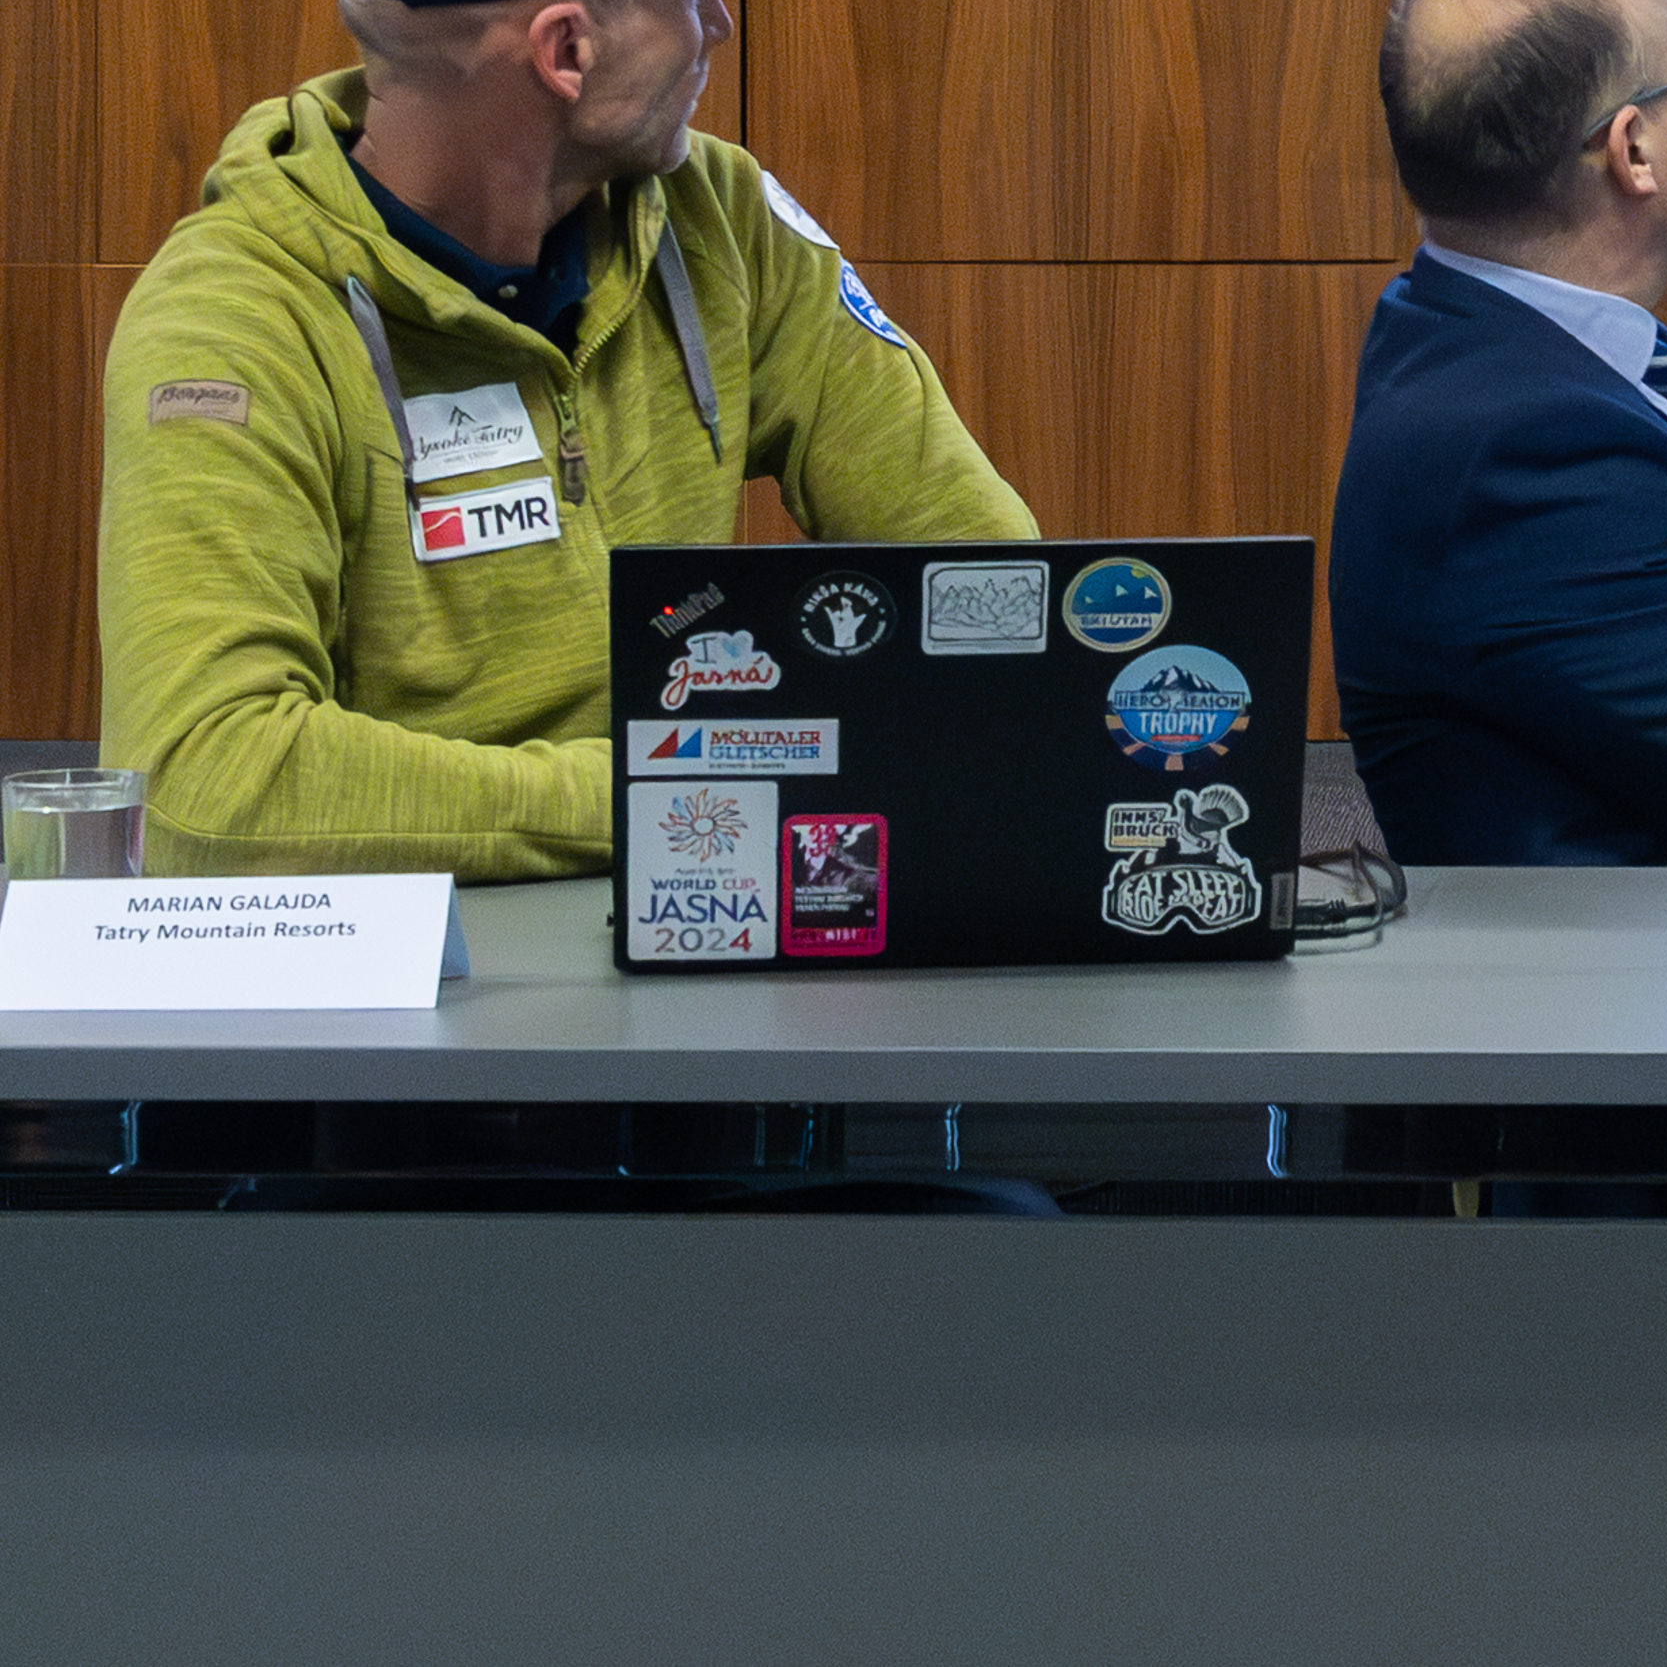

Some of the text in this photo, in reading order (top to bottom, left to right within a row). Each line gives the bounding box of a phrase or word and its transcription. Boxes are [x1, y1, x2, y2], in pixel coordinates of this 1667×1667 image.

[467, 496, 551, 539] TMR
[665, 655, 774, 707] Jasná
[1139, 711, 1218, 735] TROPHY
[1112, 824, 1175, 838] BRUCK
[650, 877, 757, 891] WORLD CUP
[127, 892, 332, 914] MARIAN GALAJDA
[637, 888, 768, 924] JASNÁ
[94, 919, 357, 944] Tatry Mountain Resorts
[654, 927, 752, 954] 2024
